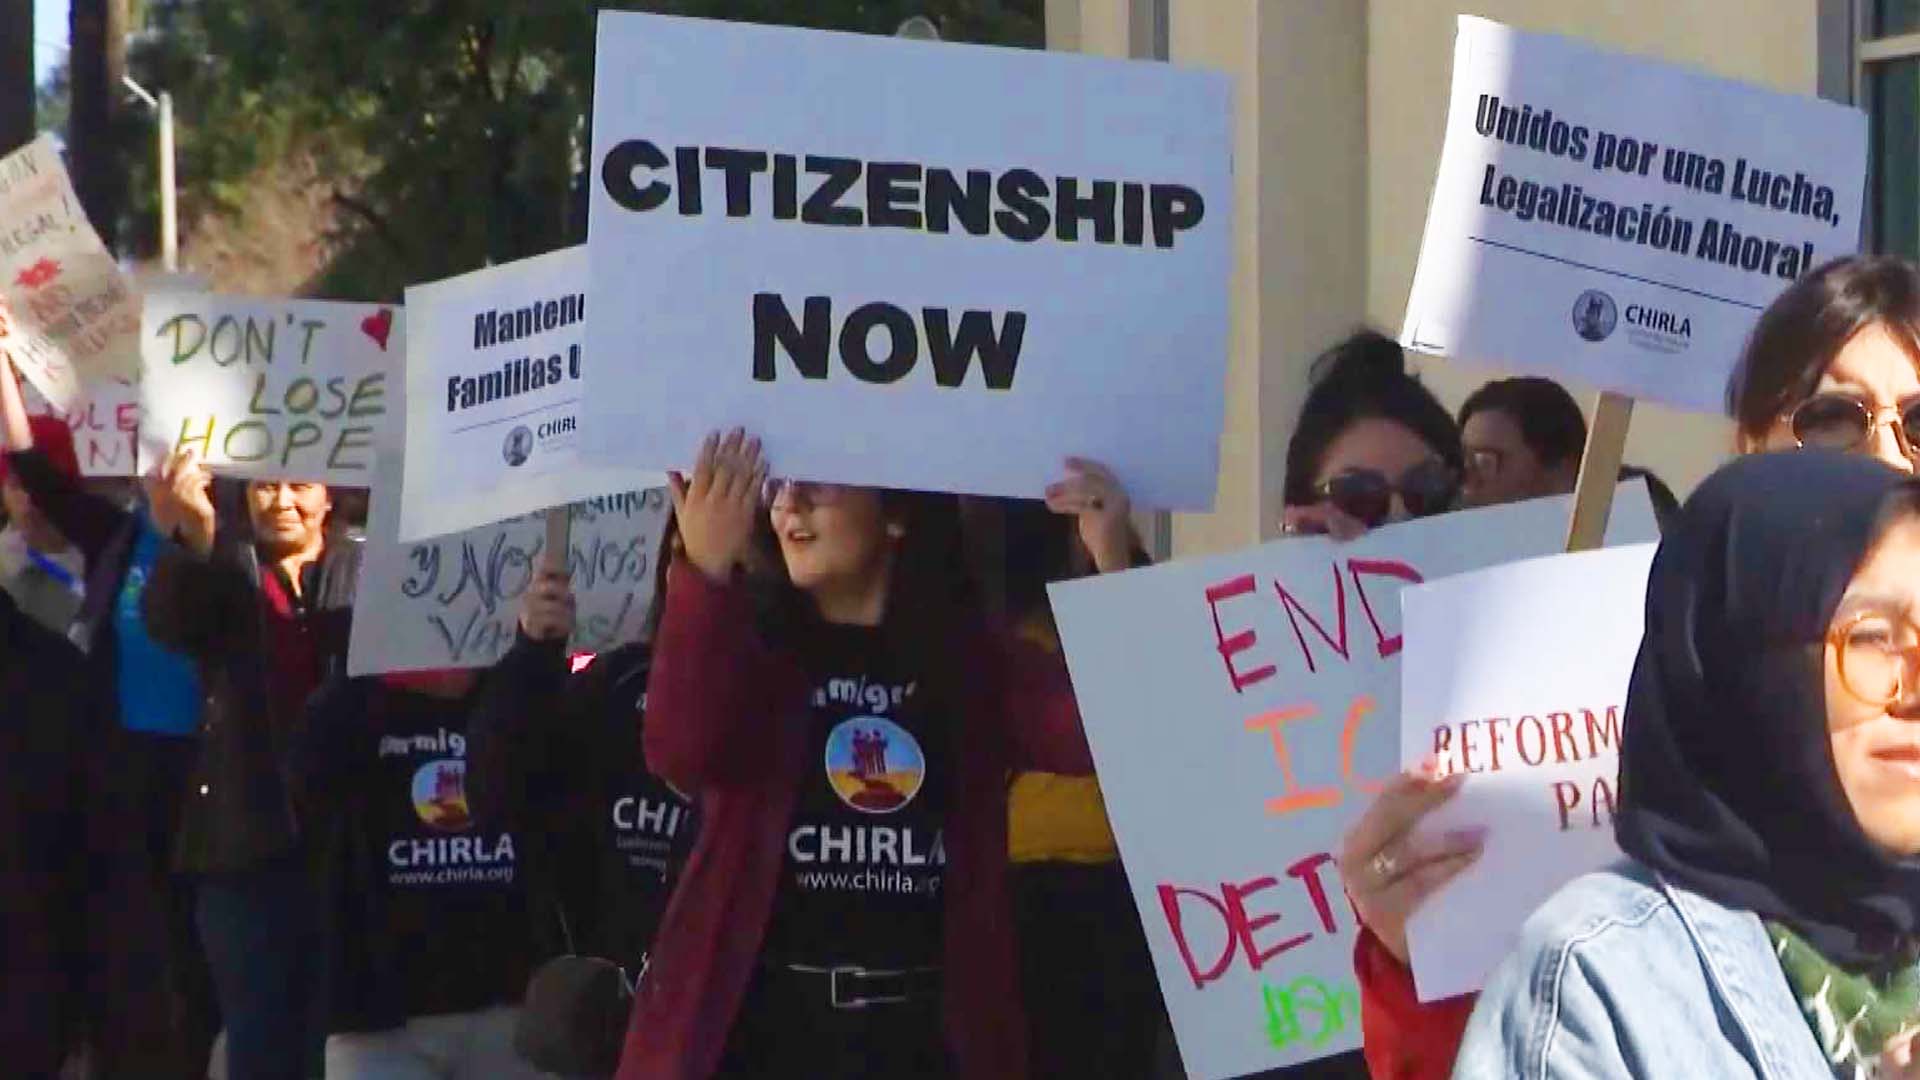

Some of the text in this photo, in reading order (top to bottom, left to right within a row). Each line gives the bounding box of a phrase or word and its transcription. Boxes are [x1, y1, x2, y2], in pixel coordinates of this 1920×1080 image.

[1475, 94, 1840, 227] Unidos por una Lucha,
[601, 139, 1205, 248] CITIZENSHIP
[1480, 163, 1693, 255] Legalización
[154, 313, 326, 366] DON'T
[752, 292, 1026, 389] NOW
[1625, 303, 1692, 339] CHIRLA
[249, 373, 386, 419] LOSE
[447, 354, 562, 413] Familias
[174, 414, 375, 470] HOPE
[1206, 557, 1424, 693] END
[388, 833, 516, 867] CHIRLA
